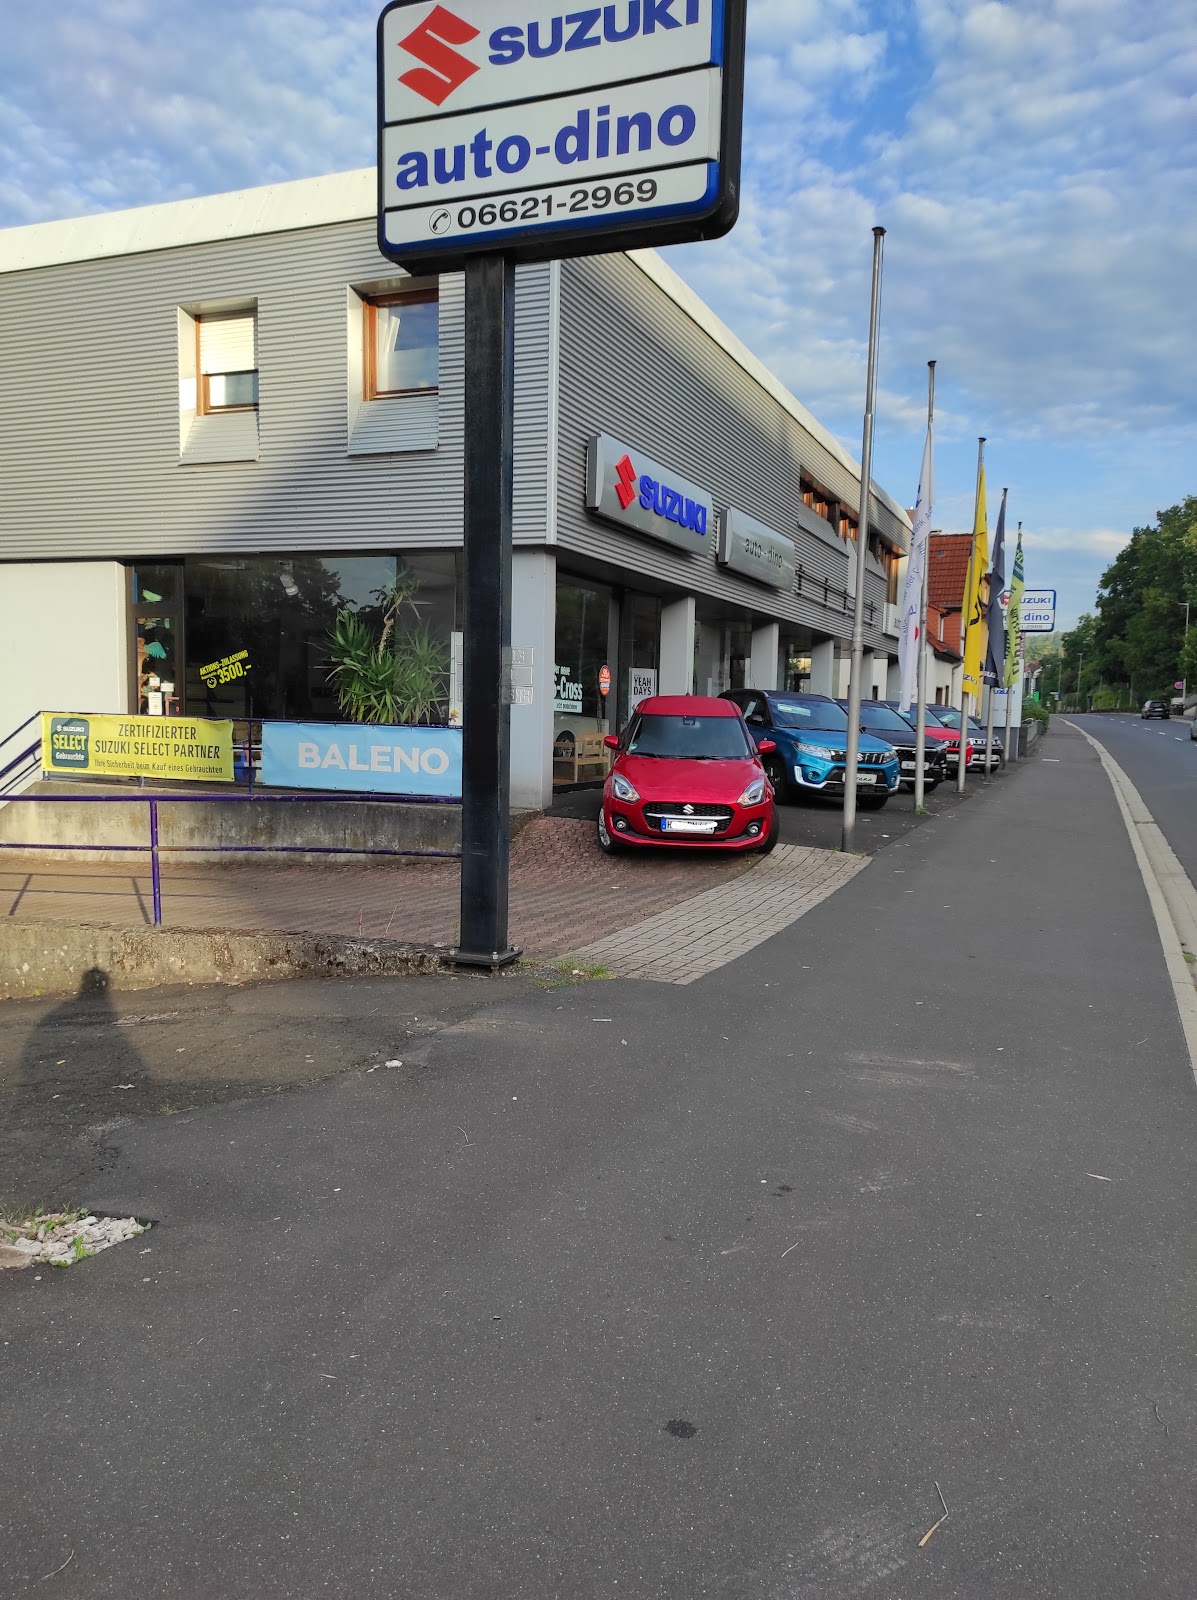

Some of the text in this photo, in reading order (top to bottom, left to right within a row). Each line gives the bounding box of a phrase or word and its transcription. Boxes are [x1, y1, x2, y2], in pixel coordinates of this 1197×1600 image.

[488, 0, 700, 66] SUZUKI
[395, 104, 696, 190] auto-dino
[457, 178, 658, 230] 06621-2969
[639, 474, 707, 536] SUZUKI
[633, 676, 652, 687] YEAH
[633, 686, 652, 696] DAYS
[63, 725, 85, 733] SUZUKI
[118, 723, 197, 740] ZERTIFIZIERTER
[52, 733, 87, 751] SELECT
[94, 740, 220, 759] SUZUKI SELECT PARTNER
[55, 751, 85, 761] Gebrauchte
[297, 741, 450, 775] BALENO
[94, 759, 223, 774] Ihre Sicherheit beim Kauf eines Gebrauchten
